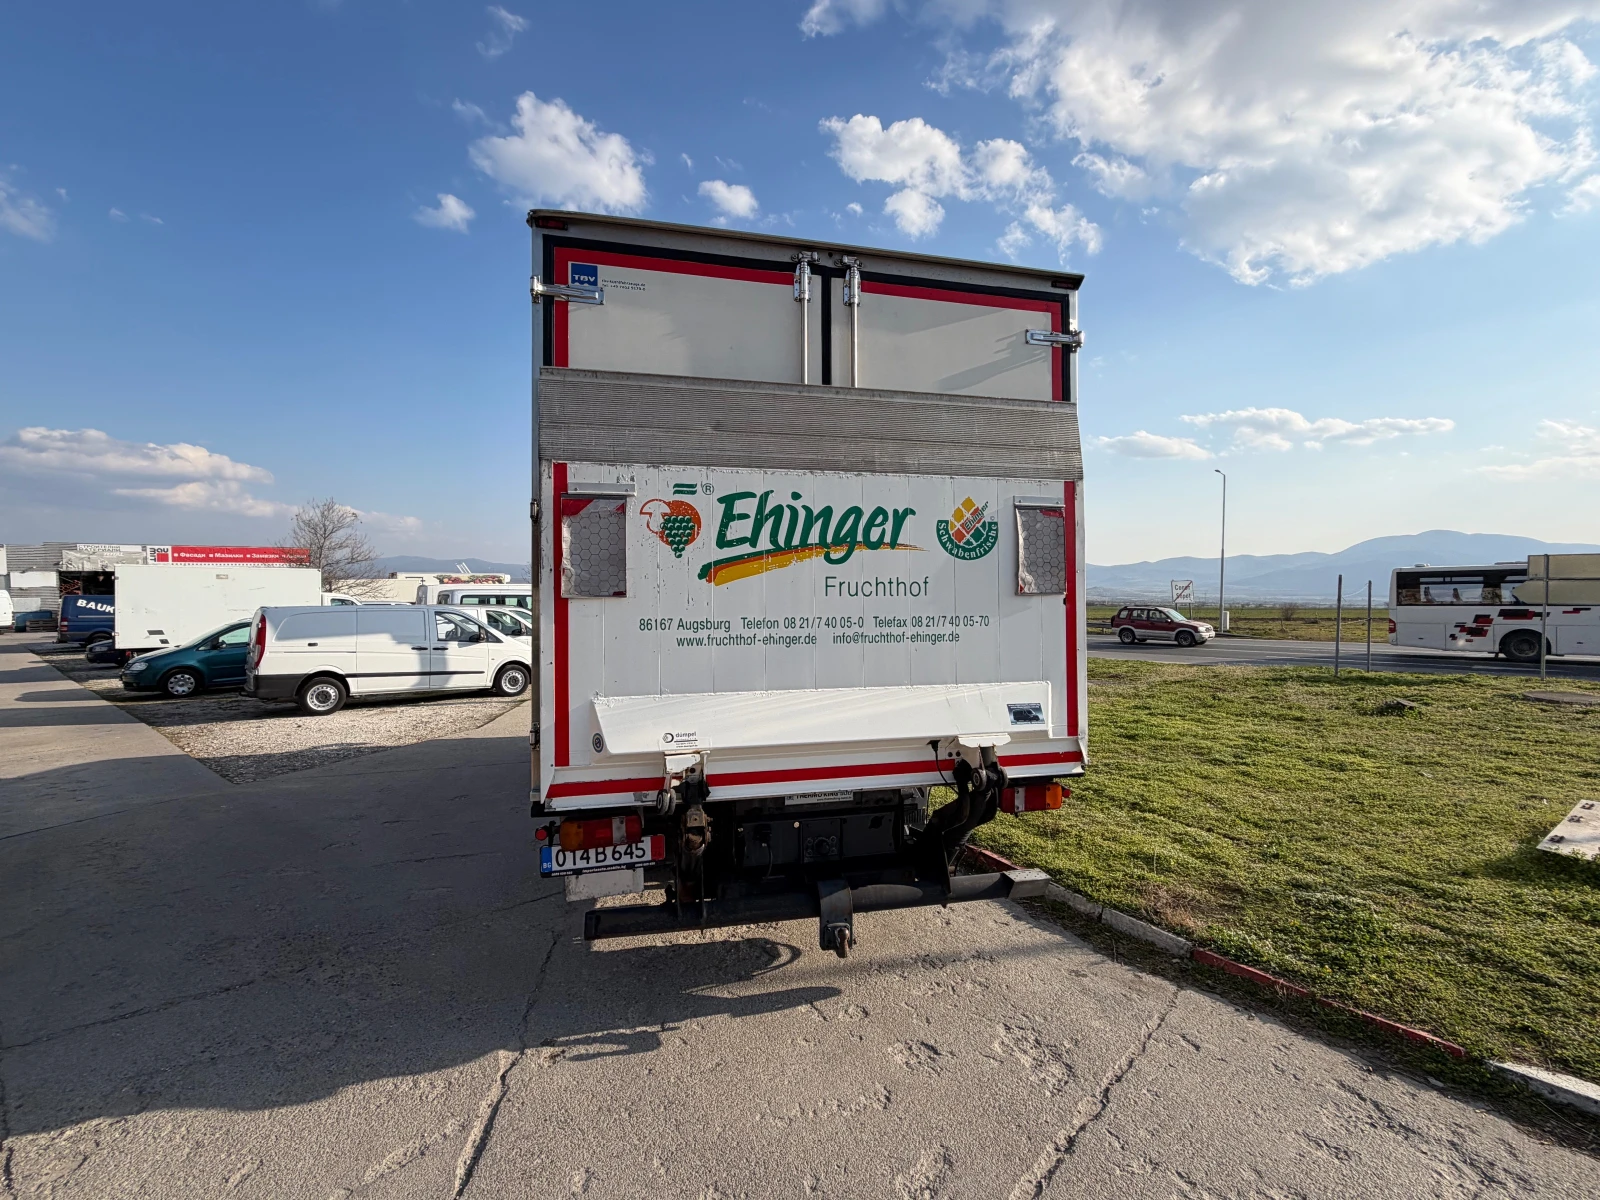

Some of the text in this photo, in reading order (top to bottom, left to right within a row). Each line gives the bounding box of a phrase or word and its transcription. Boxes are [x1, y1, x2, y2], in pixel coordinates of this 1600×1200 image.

[573, 274, 596, 282] TBV
[963, 500, 989, 531] Ehinger
[715, 489, 917, 565] Ehinger
[938, 521, 998, 560] Schwabenfrische
[825, 576, 929, 598] Fruchthof
[639, 617, 674, 631] 86167
[676, 617, 731, 633] Augsburg
[740, 616, 780, 630] Telefon
[783, 616, 797, 630] 08
[824, 616, 837, 629] 40
[839, 616, 864, 629] 05-0
[872, 615, 908, 628] Telefax
[911, 615, 923, 628] 08
[948, 615, 961, 628] 40
[962, 615, 990, 628] 05-70
[676, 631, 961, 649] www.fruchthof-ehinger.de info@fruchthof-ehinger.de
